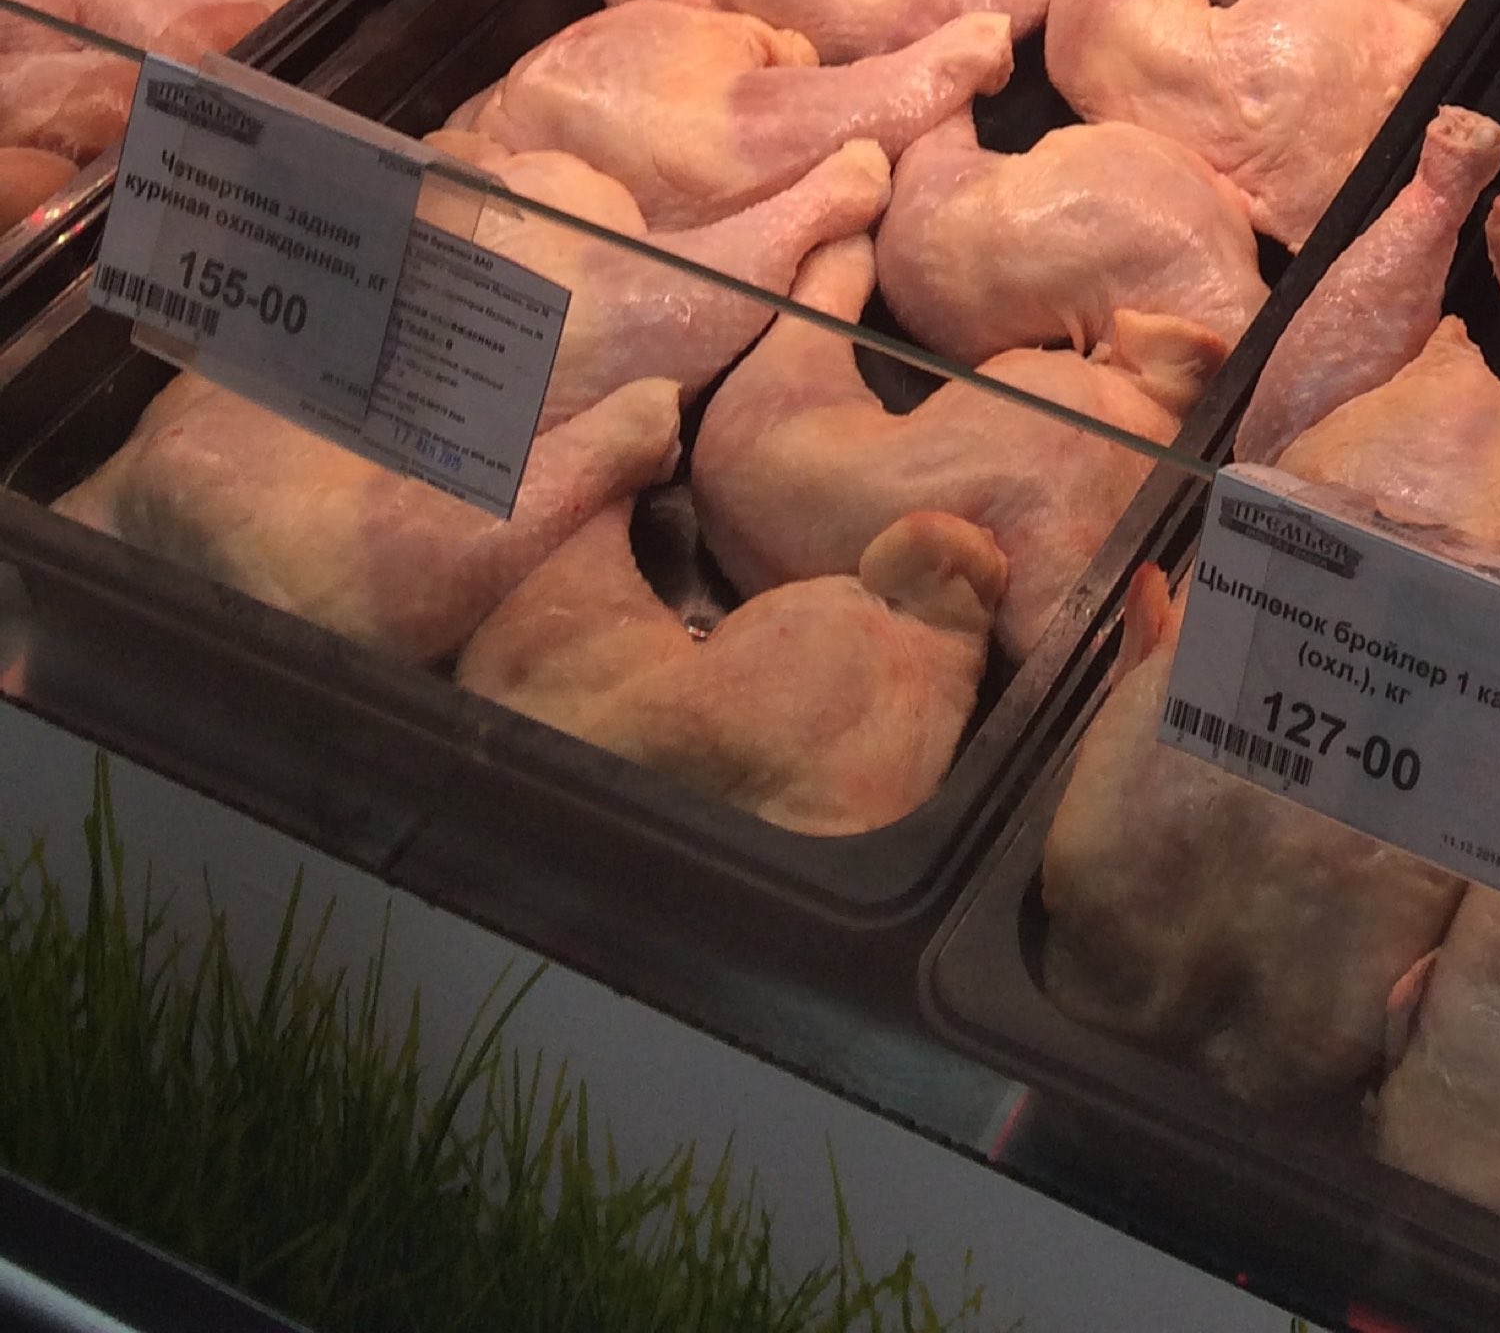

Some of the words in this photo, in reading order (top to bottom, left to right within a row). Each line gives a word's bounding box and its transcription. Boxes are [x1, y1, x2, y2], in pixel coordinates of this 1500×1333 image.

[124, 171, 211, 221] куриная
[214, 209, 362, 286] охлажденная,
[367, 272, 389, 295] кг
[159, 148, 280, 219] Четвертина
[285, 203, 361, 250] задняя
[179, 249, 308, 335] 155-00
[1228, 499, 1354, 564] ПРЕМЬЕР
[1197, 560, 1329, 636] Цыпленок
[1333, 619, 1448, 689] бройлер
[1456, 671, 1470, 695] 1
[1298, 640, 1377, 697] (охл.),
[1384, 680, 1412, 706] кг
[1262, 690, 1422, 792] 127-00
